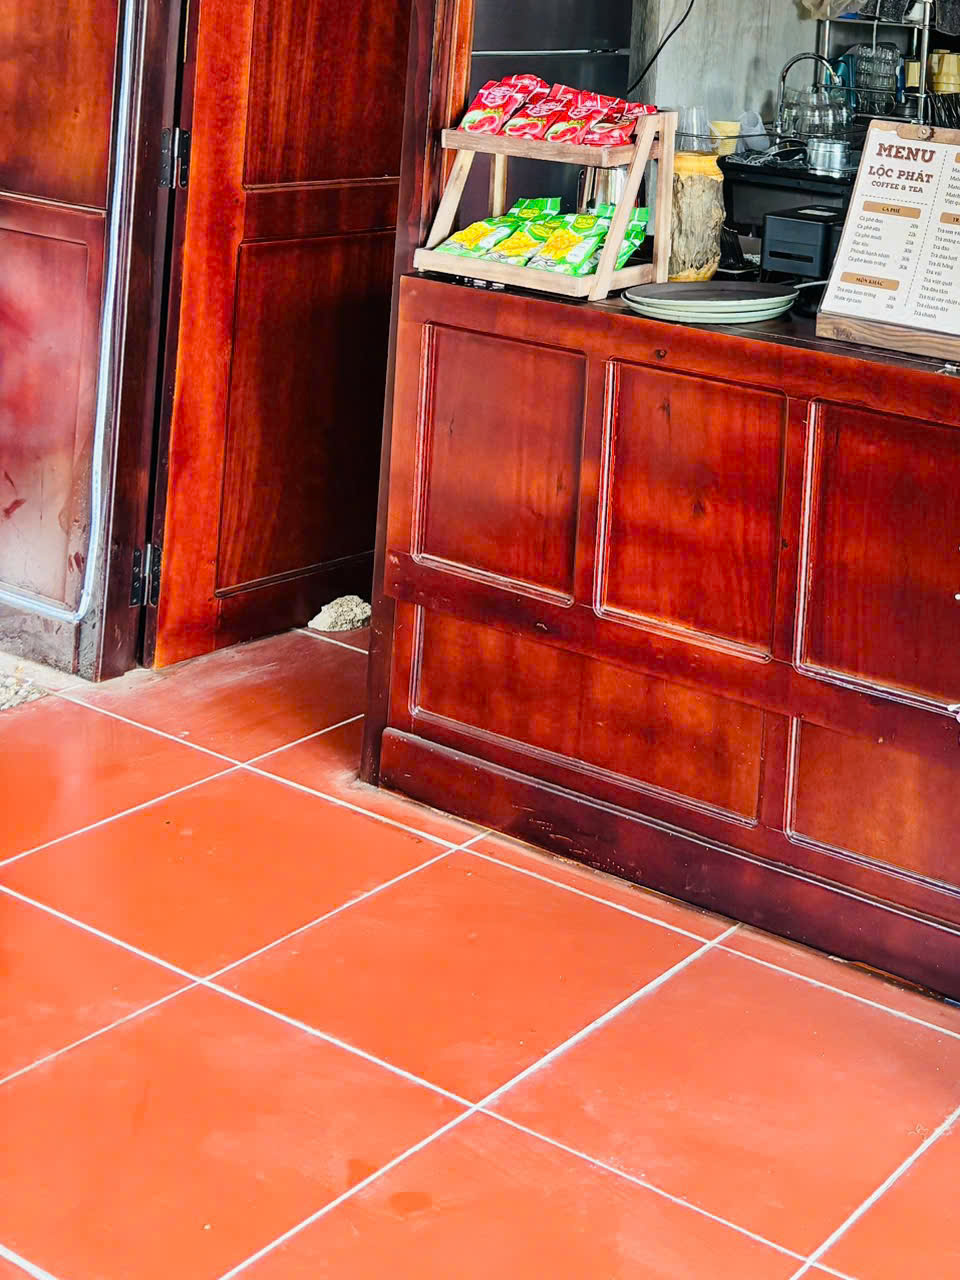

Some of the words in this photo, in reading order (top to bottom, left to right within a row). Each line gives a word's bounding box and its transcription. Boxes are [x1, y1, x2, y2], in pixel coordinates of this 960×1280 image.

[876, 143, 936, 163] MENU
[868, 164, 893, 179] LỘC
[897, 170, 933, 183] PHÁT
[872, 181, 899, 190] COFFEE
